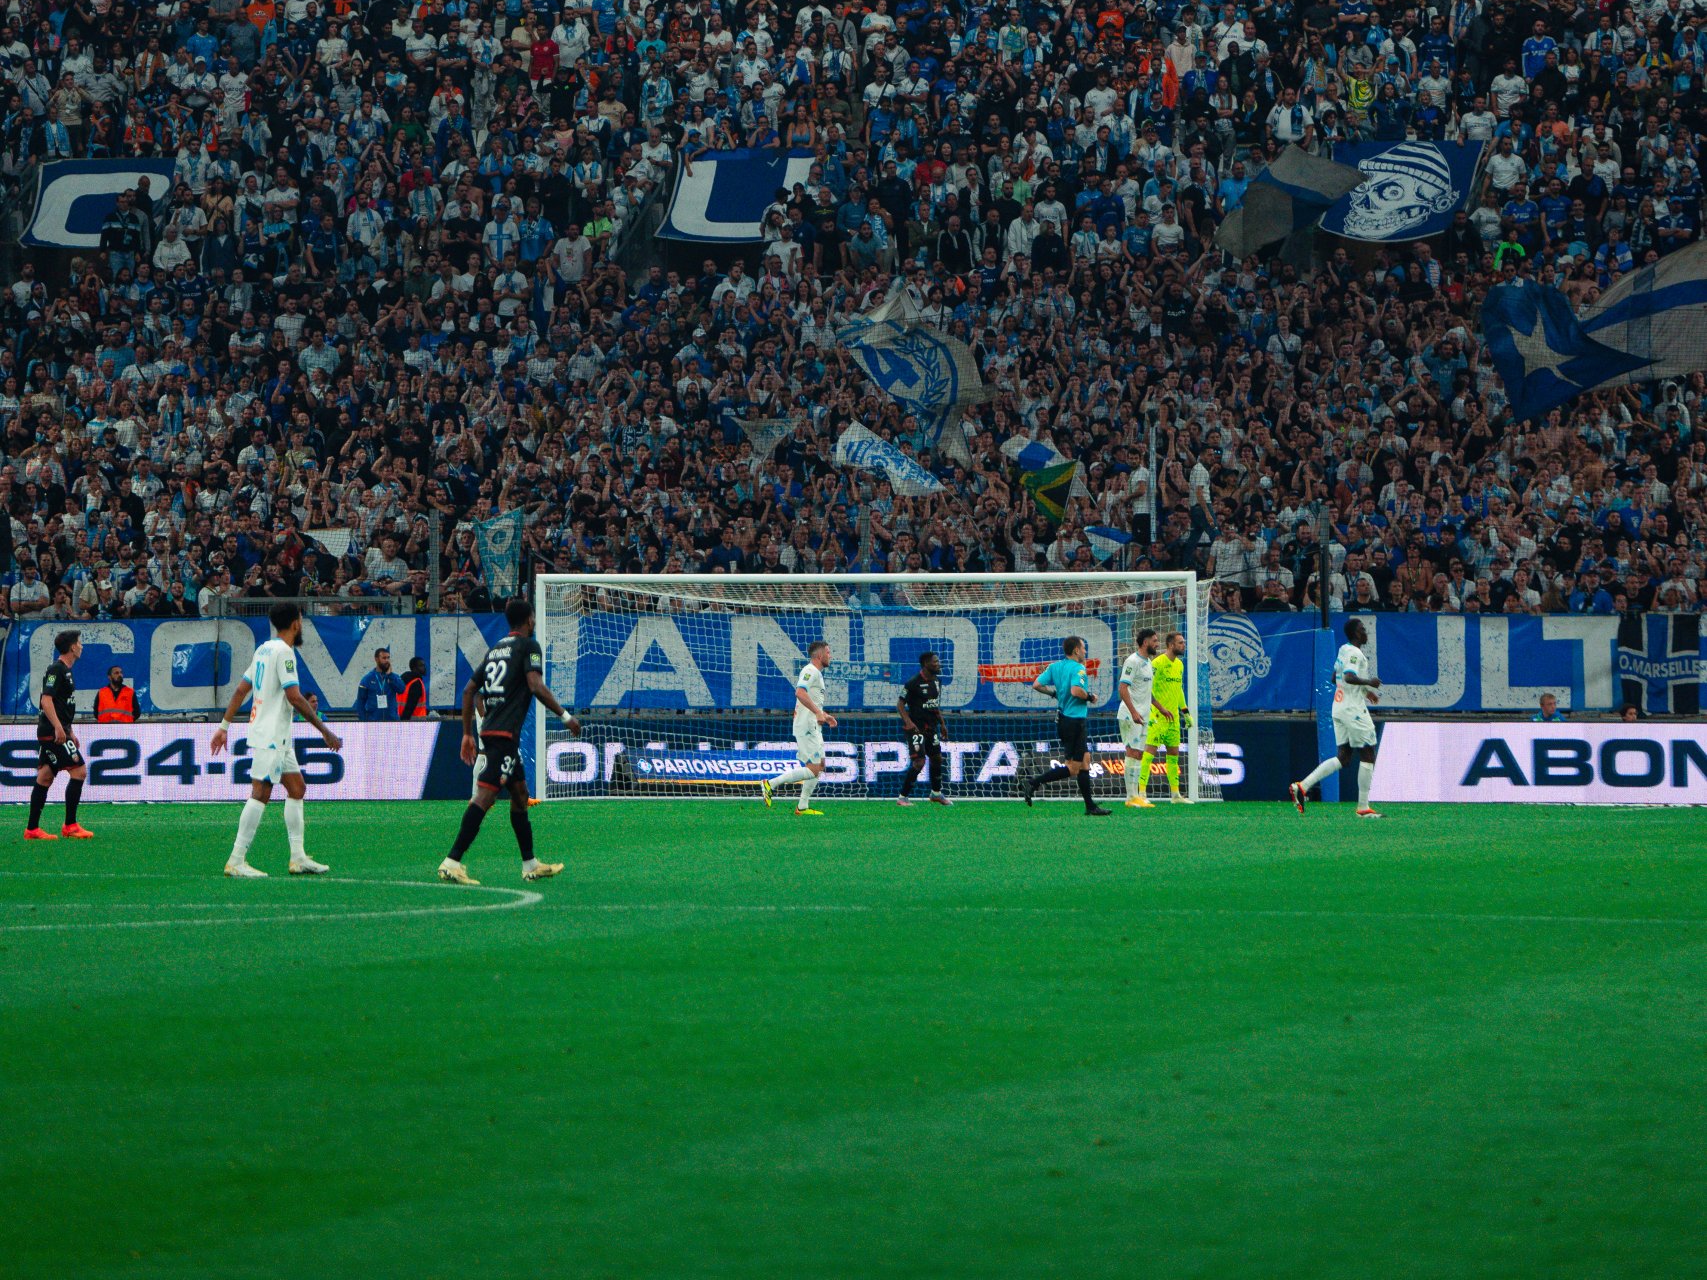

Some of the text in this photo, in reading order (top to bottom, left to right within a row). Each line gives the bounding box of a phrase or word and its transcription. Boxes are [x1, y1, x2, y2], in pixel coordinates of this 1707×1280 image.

[28, 612, 1707, 715] COMMANDO ULT
[1619, 654, 1700, 678] O.MARSEILLE
[484, 659, 507, 693] 32
[62, 740, 77, 755] 19
[912, 733, 924, 745] 27
[654, 758, 799, 774] PARIONS SPORT
